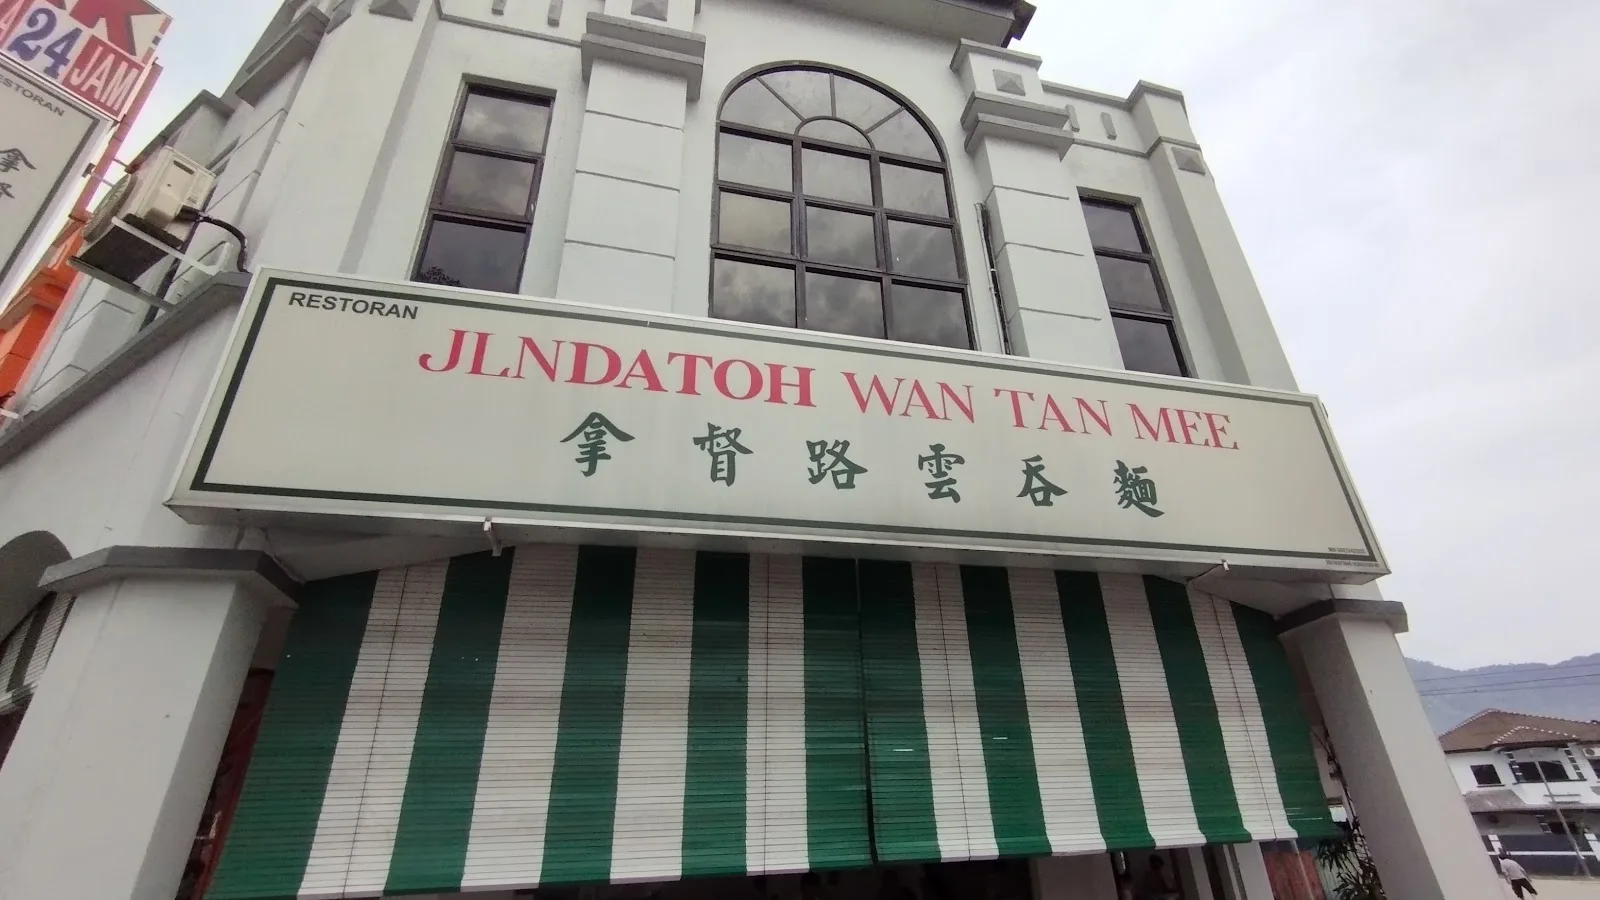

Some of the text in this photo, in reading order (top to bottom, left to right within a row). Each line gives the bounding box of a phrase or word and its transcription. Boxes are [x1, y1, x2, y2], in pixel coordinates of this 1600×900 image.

[8, 8, 83, 79] 24
[70, 45, 140, 111] JAM
[289, 285, 418, 320] RESTORAN
[419, 329, 1240, 450] JLNDATOH WAN TAN MEE
[560, 411, 1165, 518] 拿督路雲吞麵
